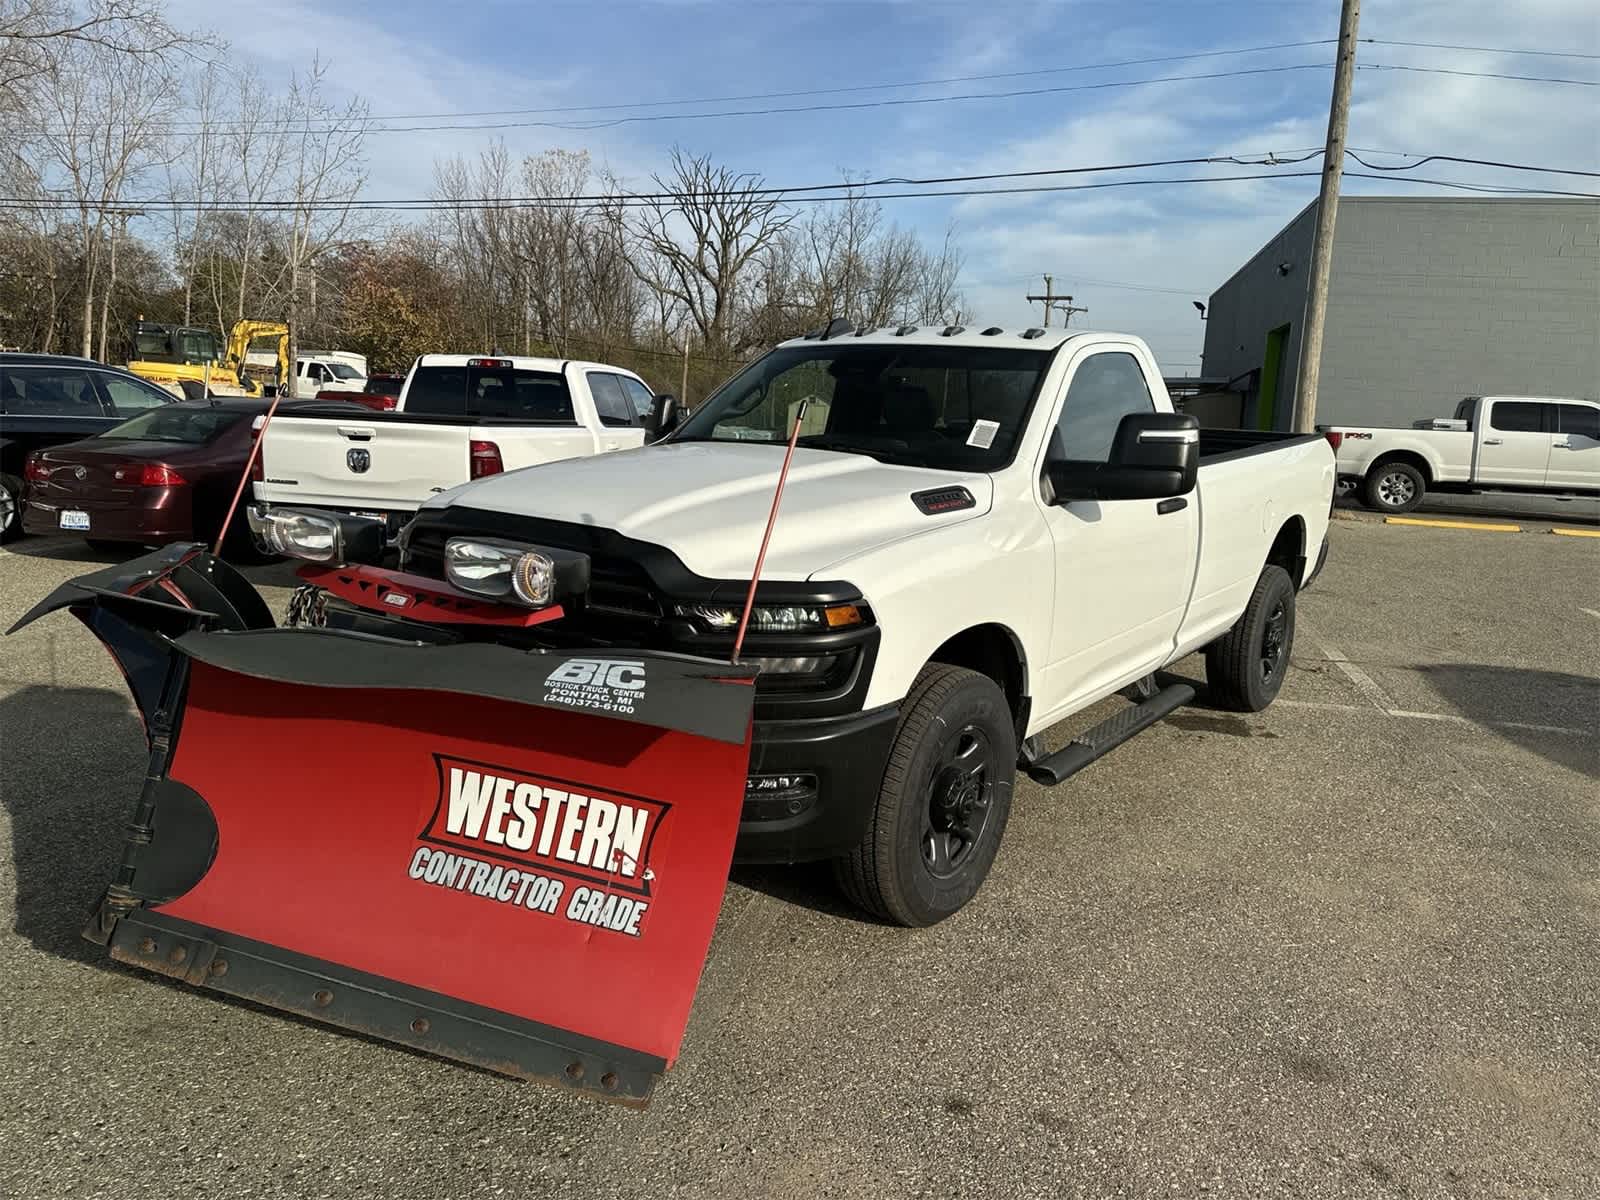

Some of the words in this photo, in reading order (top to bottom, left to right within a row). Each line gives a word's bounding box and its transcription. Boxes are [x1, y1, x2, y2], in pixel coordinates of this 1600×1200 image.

[546, 658, 646, 690] BTC
[544, 680, 580, 691] BOSTICK
[582, 684, 609, 695] TRUCK
[613, 688, 646, 700] CENTER
[551, 687, 613, 704] PONTIAC,
[616, 696, 633, 706] MI
[543, 694, 635, 714] (248)373-6100
[446, 767, 649, 877] WESTERN
[408, 846, 566, 915] CONTRACTOR
[565, 886, 649, 937] GRADE
